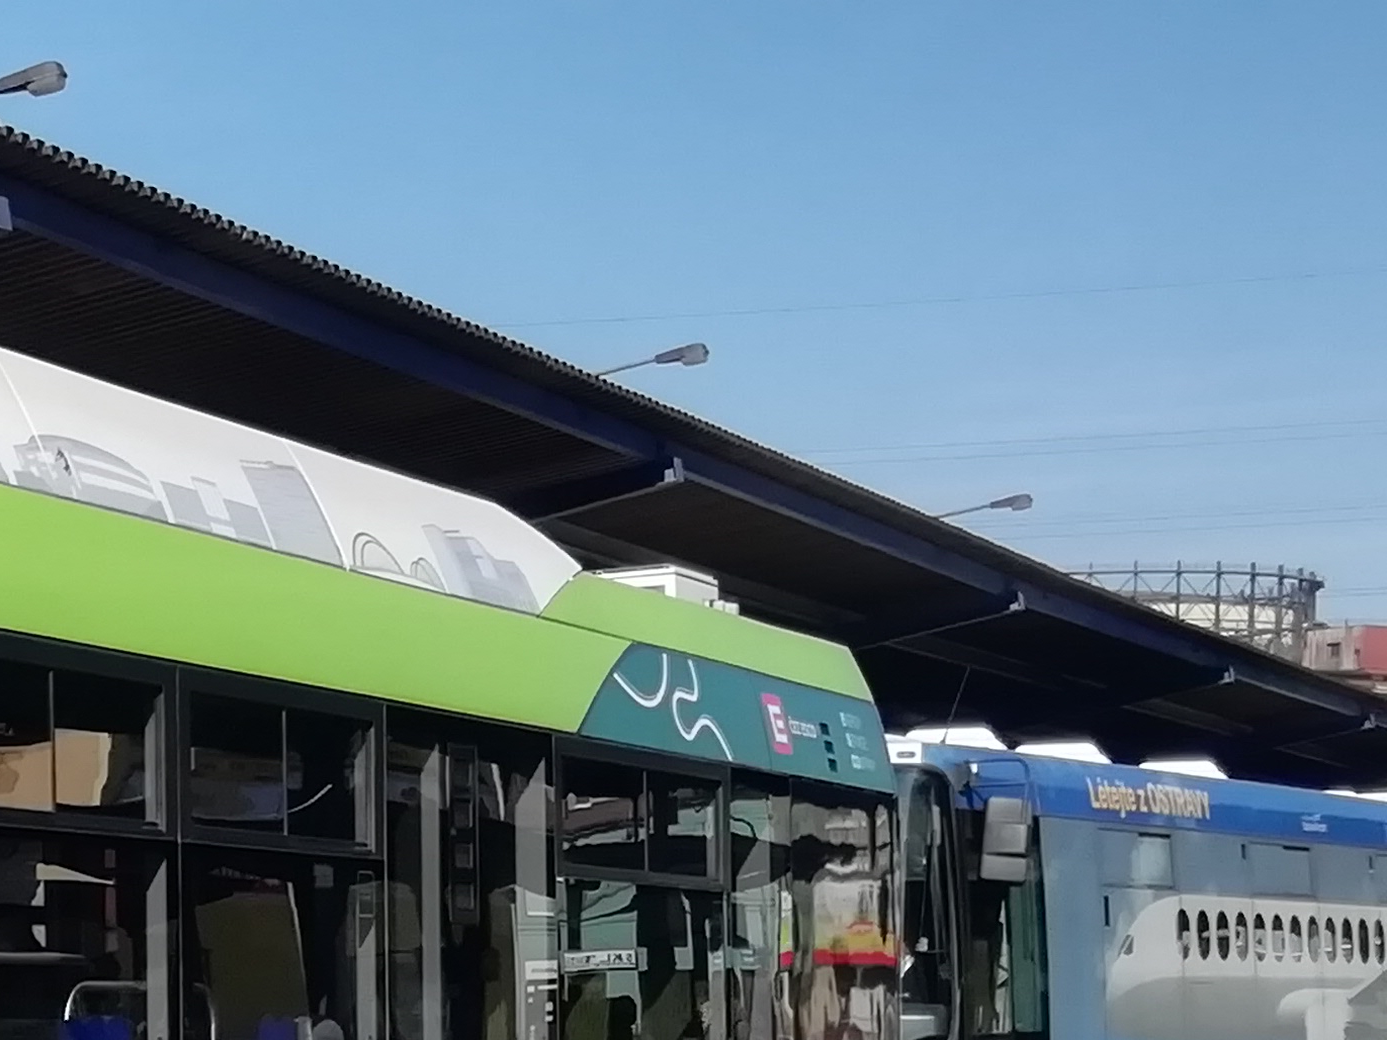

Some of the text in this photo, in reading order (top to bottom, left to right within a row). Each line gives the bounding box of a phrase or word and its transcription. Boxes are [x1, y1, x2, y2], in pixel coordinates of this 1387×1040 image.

[1086, 776, 1211, 820] Létejte z OSTRAVY
